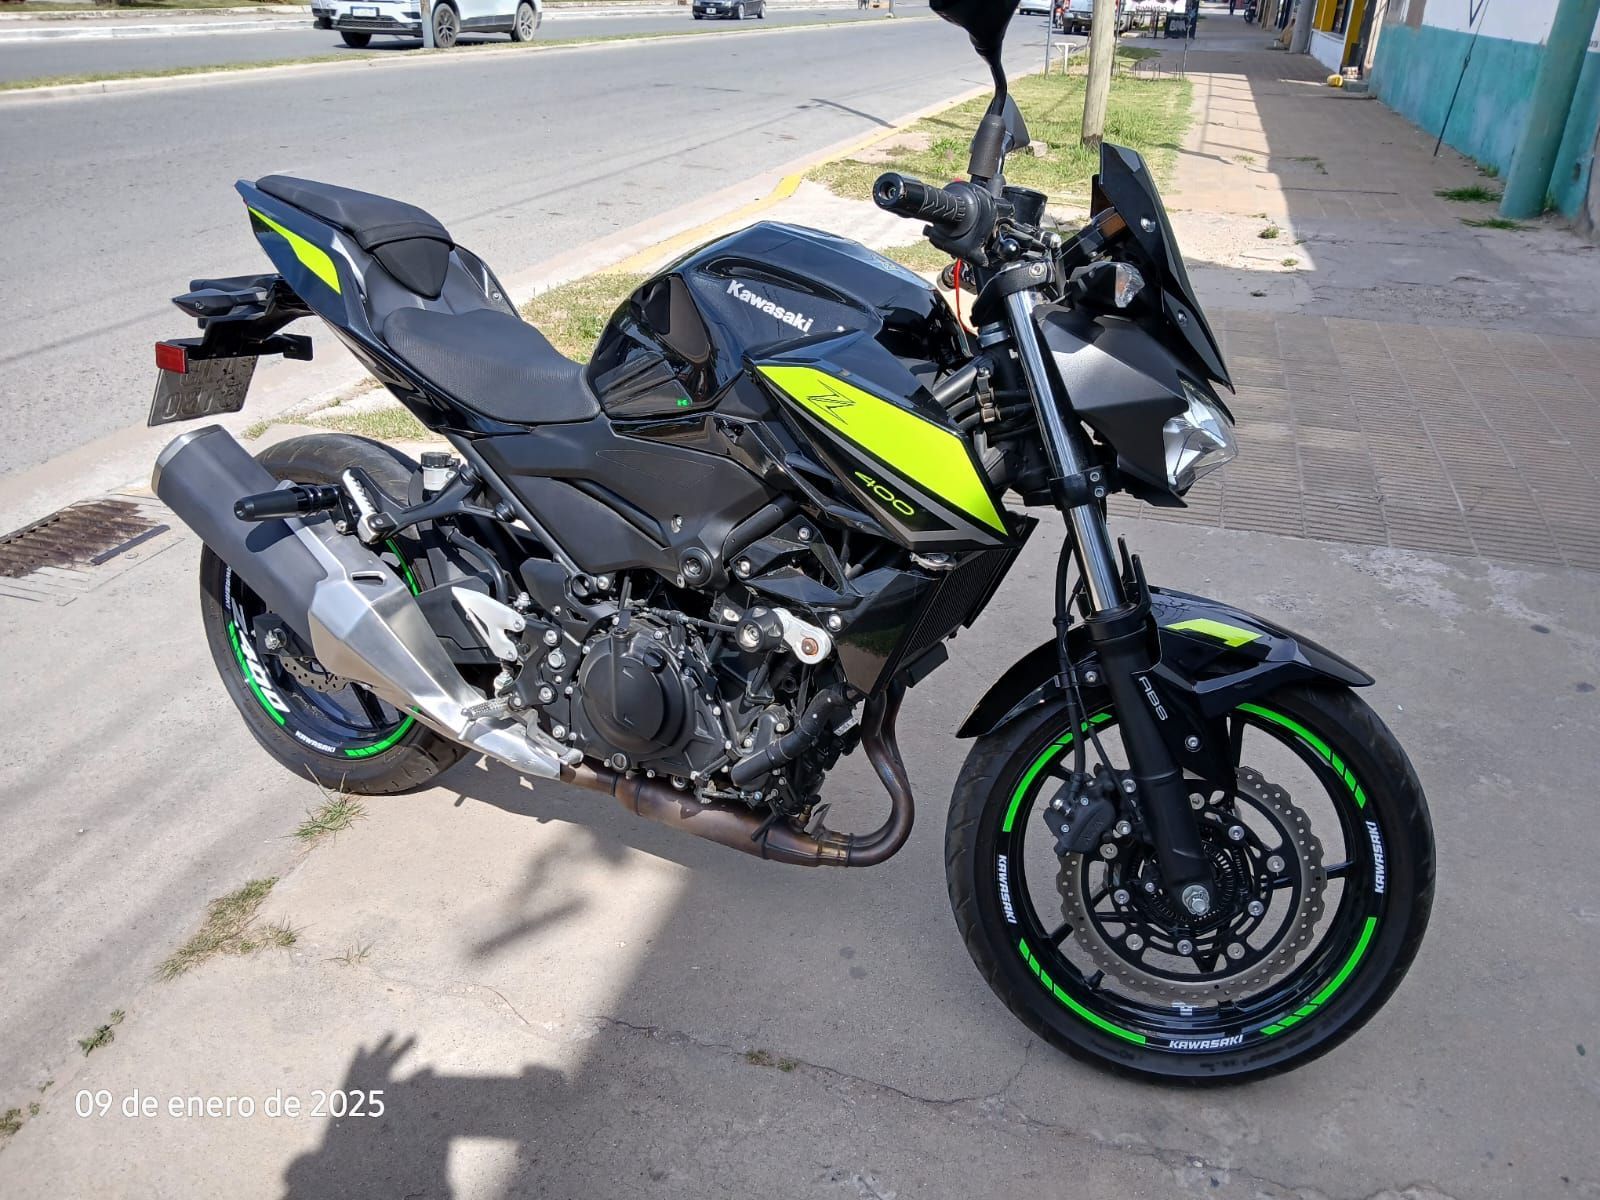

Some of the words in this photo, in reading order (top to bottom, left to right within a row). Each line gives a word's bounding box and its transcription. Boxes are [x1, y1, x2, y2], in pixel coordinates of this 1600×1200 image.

[726, 279, 814, 332] Kawasaki
[854, 471, 915, 516] 400
[1138, 676, 1169, 721] ABS
[295, 730, 336, 753] KAWASAKI
[1365, 820, 1385, 894] KAWASAKI
[998, 854, 1018, 924] KAWASAKI
[1168, 1034, 1244, 1050] KAWASAKI
